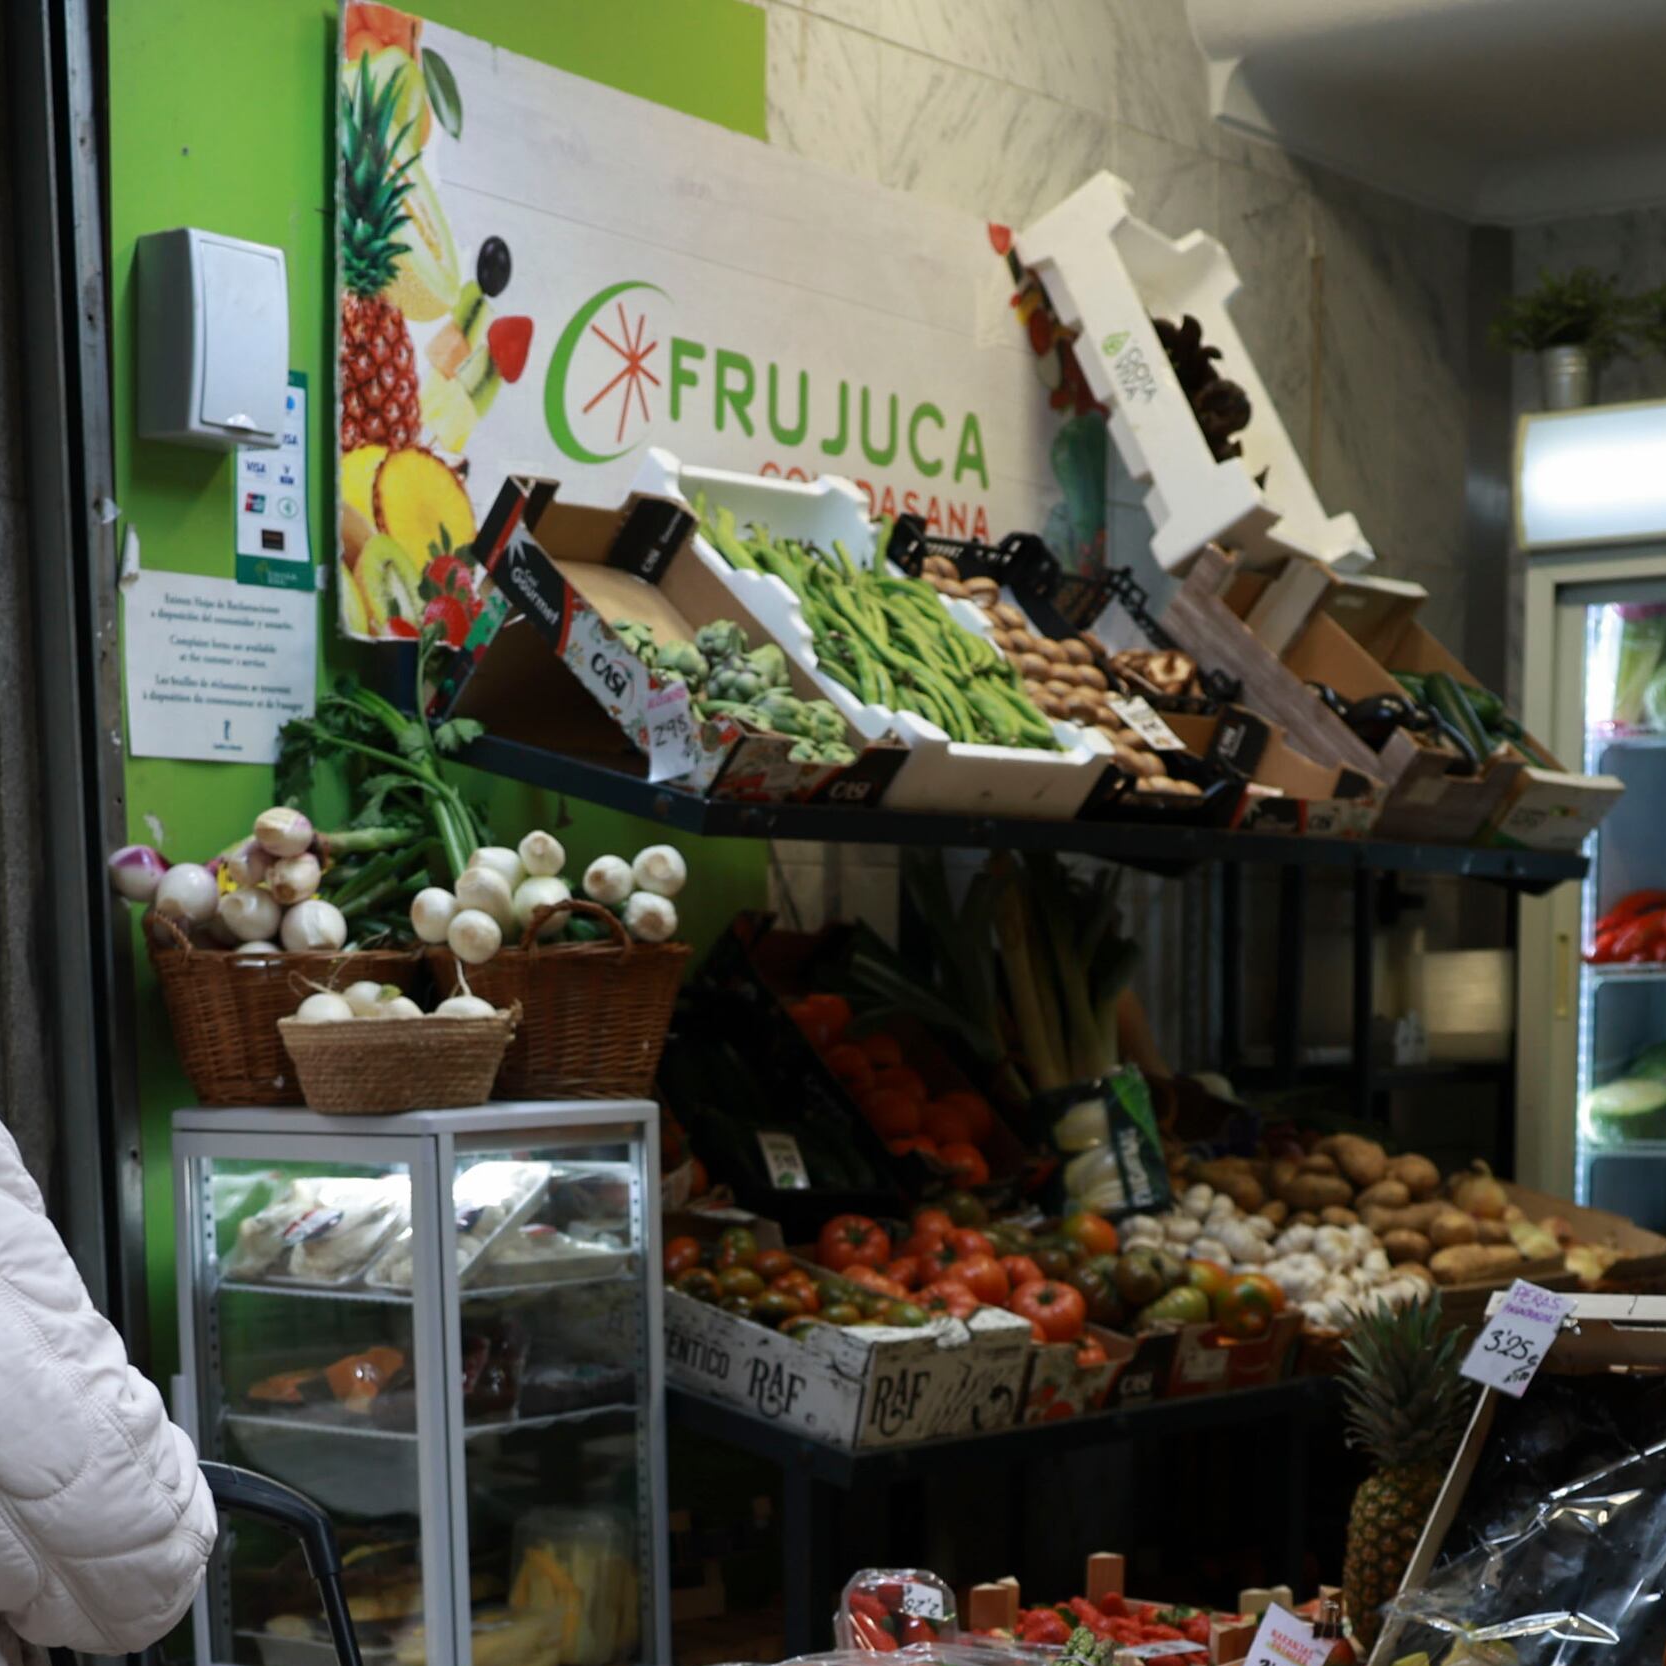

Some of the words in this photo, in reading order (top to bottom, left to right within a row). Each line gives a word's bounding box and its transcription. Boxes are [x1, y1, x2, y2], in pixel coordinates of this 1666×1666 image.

[669, 336, 990, 491] FRUJUCA
[759, 461, 991, 544] DASANA
[590, 652, 629, 698] CASI
[746, 1355, 808, 1421] RAF
[869, 1368, 932, 1437] RAF
